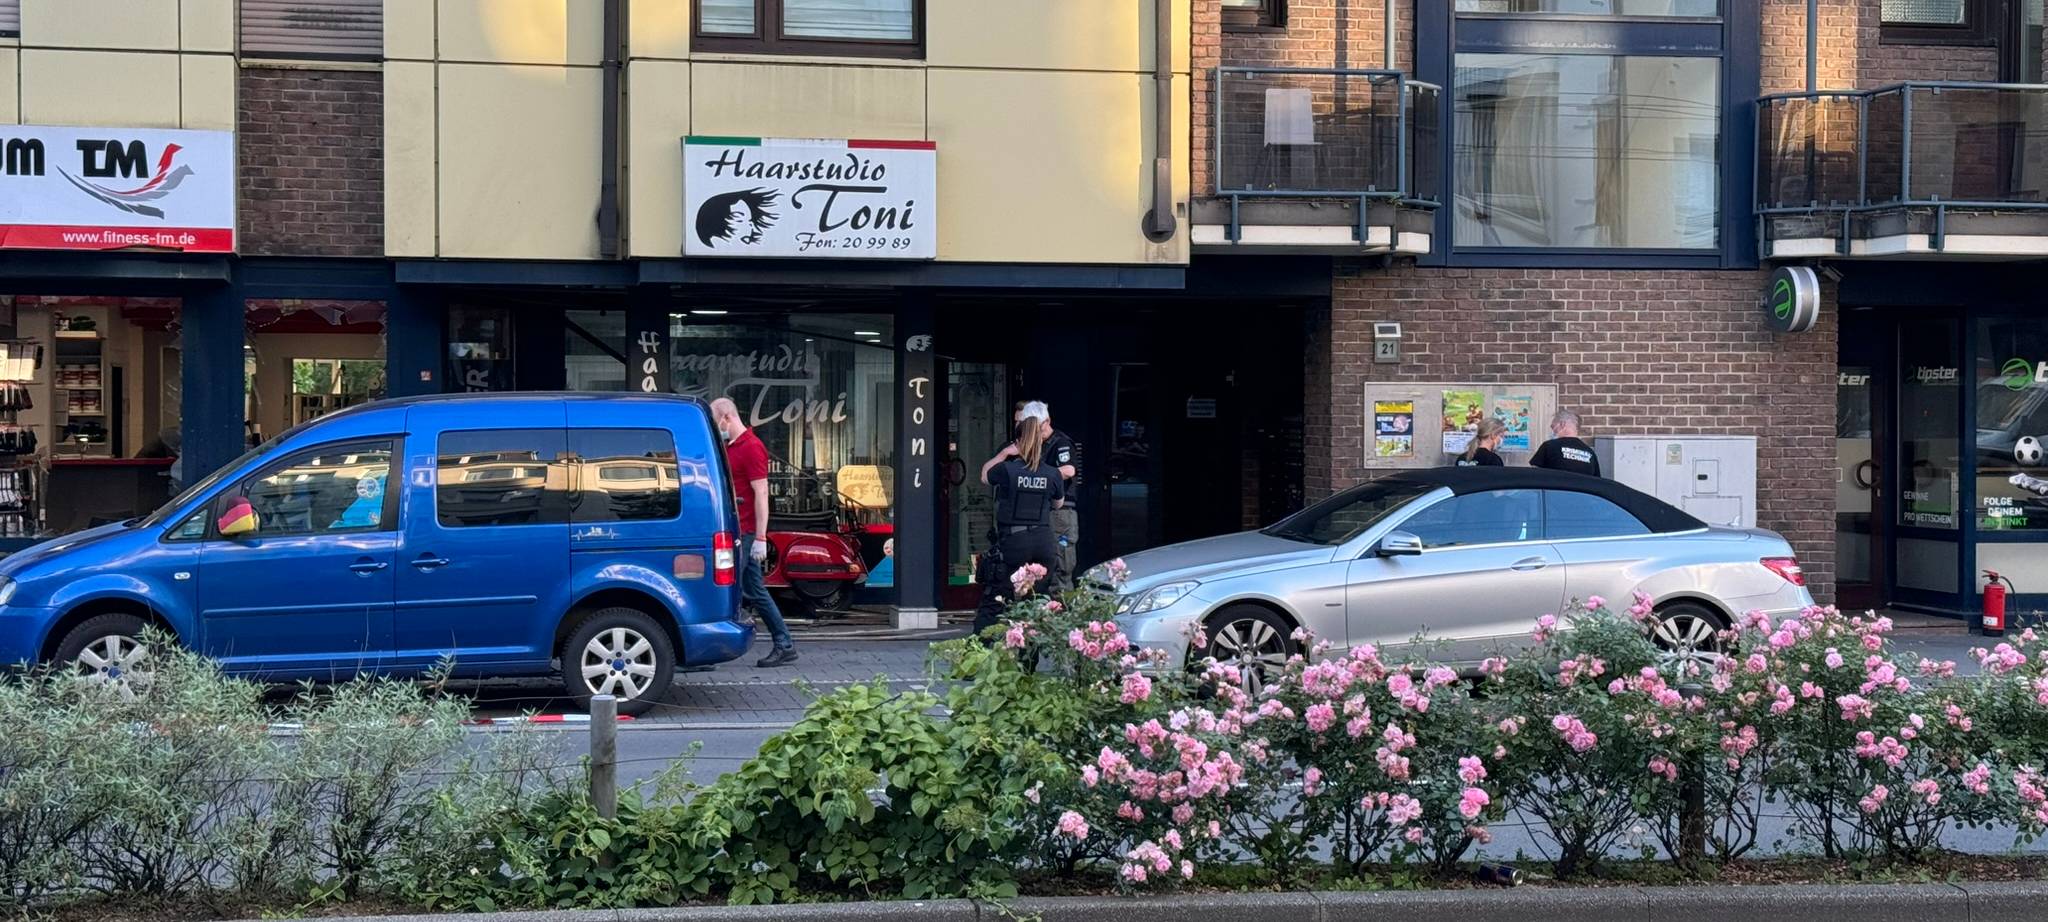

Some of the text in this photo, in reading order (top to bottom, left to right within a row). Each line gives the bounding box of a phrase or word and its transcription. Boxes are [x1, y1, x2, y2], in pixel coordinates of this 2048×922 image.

[77, 140, 149, 178] TM
[705, 149, 886, 181] Haarstudio
[792, 184, 915, 233] Toni
[62, 230, 196, 246] www.fitness-tm.de
[796, 233, 911, 251] Fon: 20 99 89
[1381, 343, 1395, 354] 21
[1917, 366, 1958, 383] tipster
[724, 378, 848, 428] Toni
[908, 376, 930, 489] Toni
[1017, 476, 1048, 489] POLIZEI
[1983, 497, 2013, 506] FOLGE
[1988, 507, 2023, 517] DEINEM
